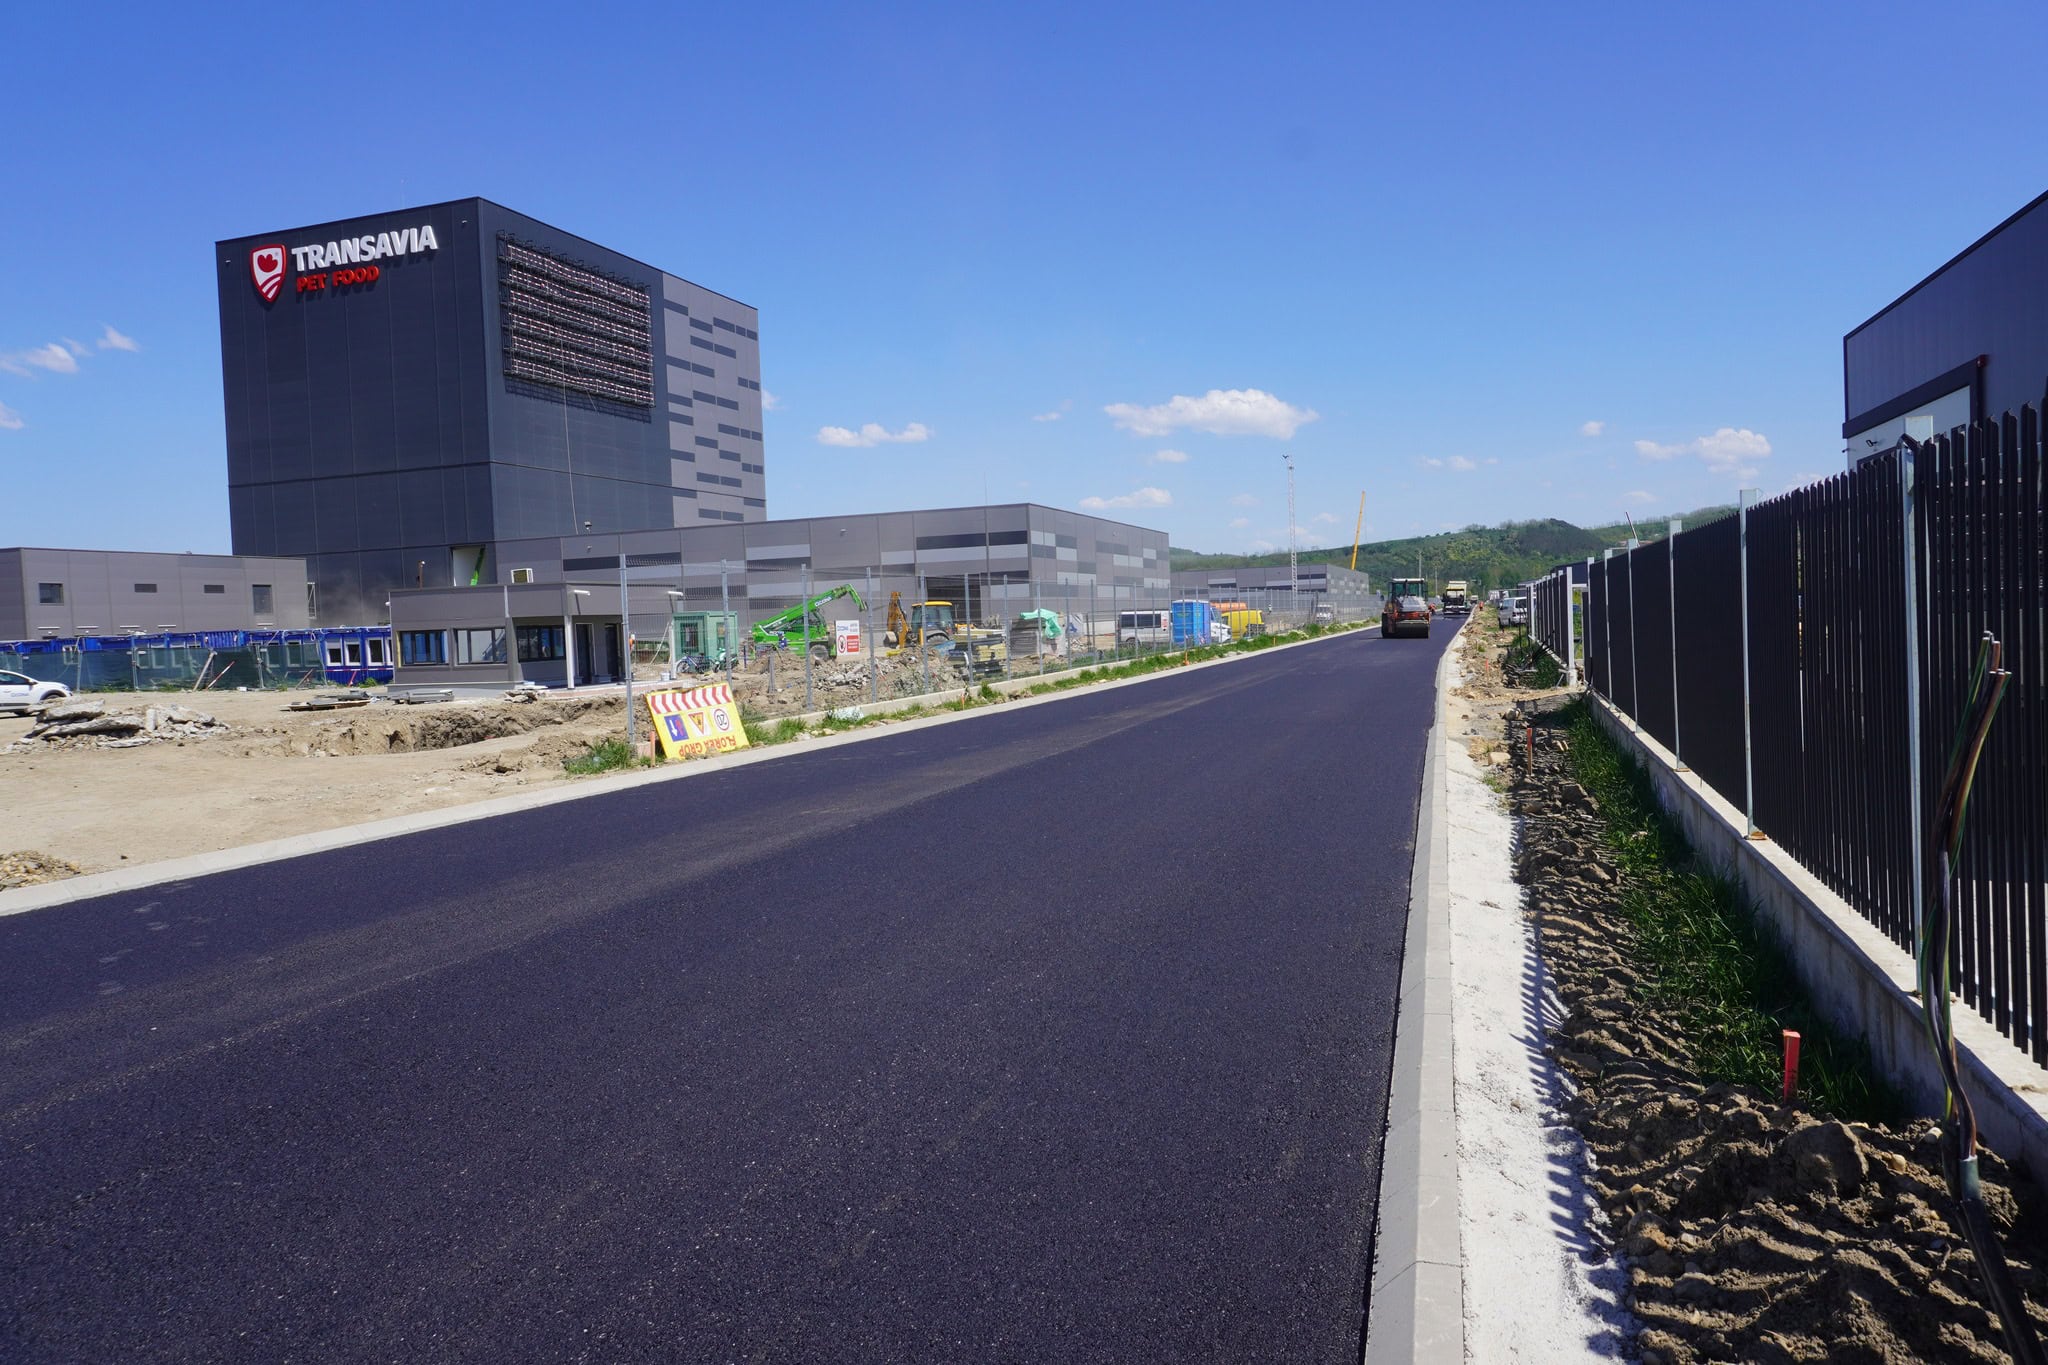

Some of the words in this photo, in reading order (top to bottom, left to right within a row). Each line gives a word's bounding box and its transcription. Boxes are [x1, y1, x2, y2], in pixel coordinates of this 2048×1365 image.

[291, 225, 438, 271] TRANSAVIA
[296, 273, 328, 292] PET
[332, 265, 380, 287] FOOD
[678, 741, 703, 757] GRUP
